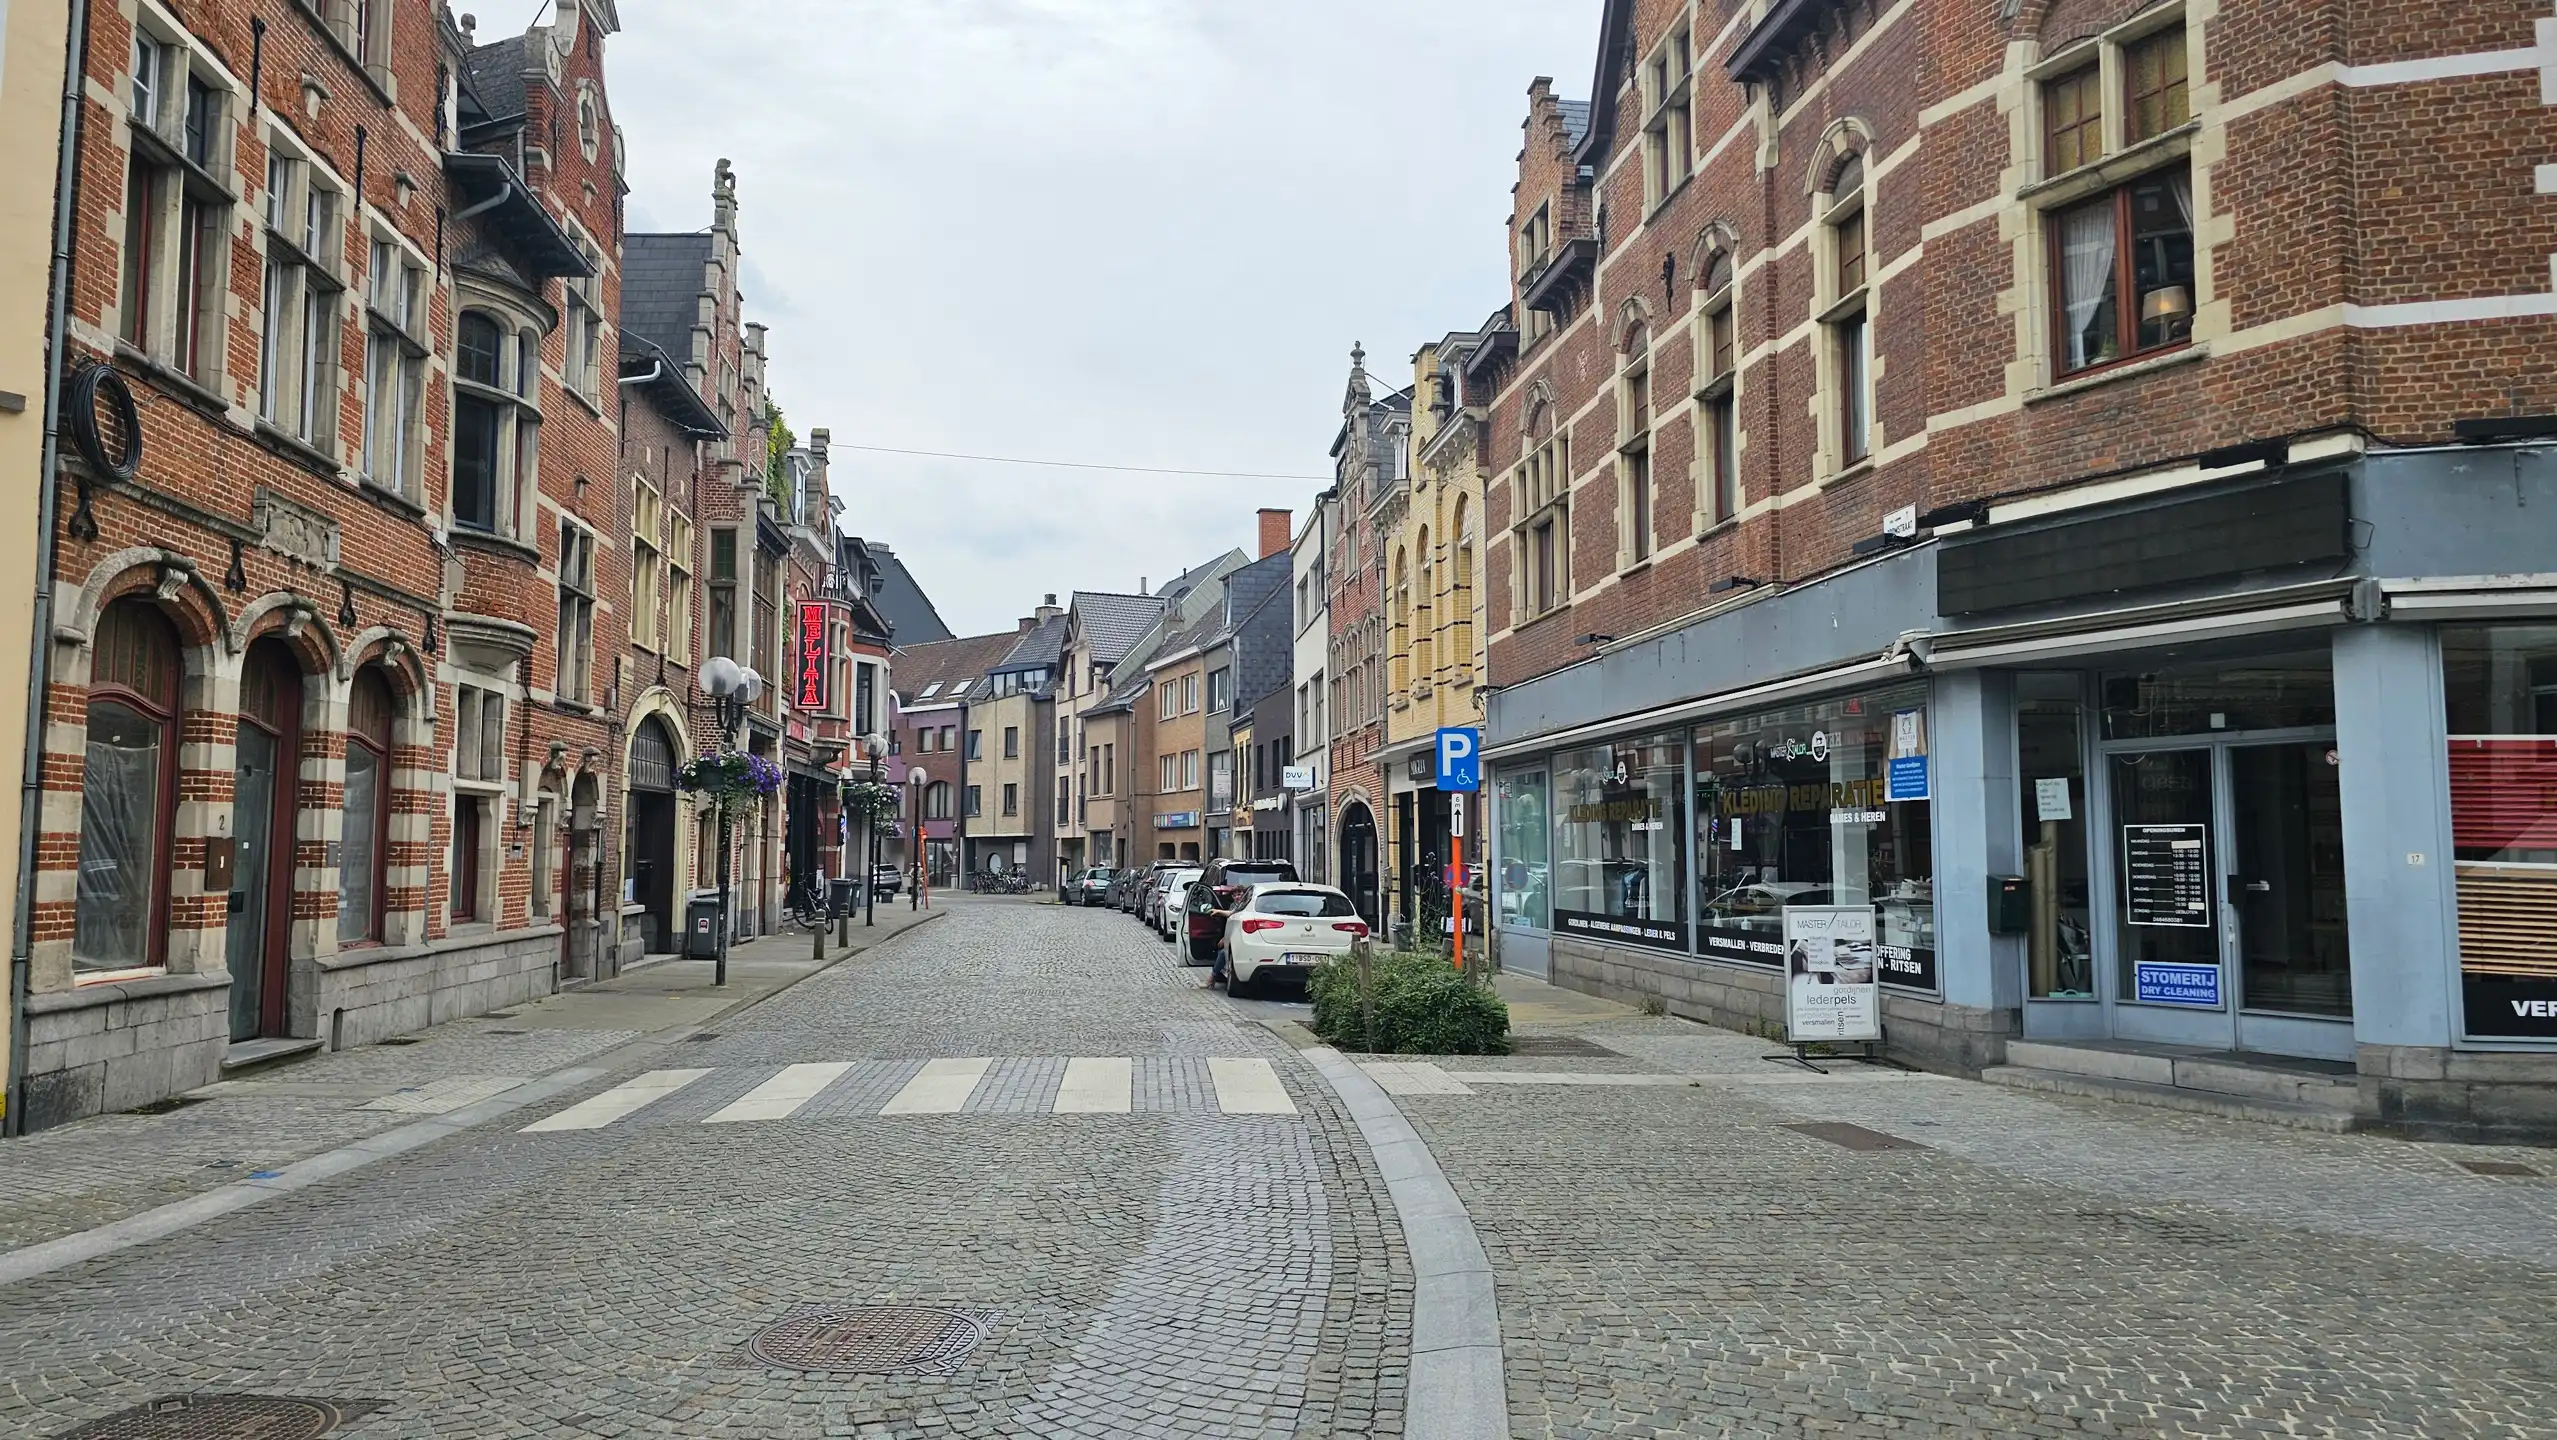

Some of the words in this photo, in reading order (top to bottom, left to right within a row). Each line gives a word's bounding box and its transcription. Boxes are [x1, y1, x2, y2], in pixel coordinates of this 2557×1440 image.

[801, 605, 823, 705] MELITA
[1442, 733, 1472, 776] P
[1723, 787, 1784, 814] KLEDING
[1789, 779, 1885, 812] REPARATIE
[218, 814, 225, 831] 2
[1830, 812, 1853, 824] DAMES
[1861, 811, 1886, 823] HEREN
[2411, 854, 2420, 864] 17
[1797, 919, 1827, 929] MASTER
[1837, 919, 1862, 929] TAILOR
[1644, 928, 1658, 939] LEDER
[1663, 931, 1676, 941] PELS
[1708, 936, 1746, 950] VERSMALLEN
[1890, 959, 1922, 975] RITSEN
[2140, 970, 2216, 987] STOMERIJ
[1833, 985, 1871, 996] gordijnen
[2141, 985, 2162, 995] DRY
[2163, 986, 2216, 998] CLEANING
[1806, 994, 1857, 1007] lederpels
[1837, 1011, 1845, 1036] ritsen
